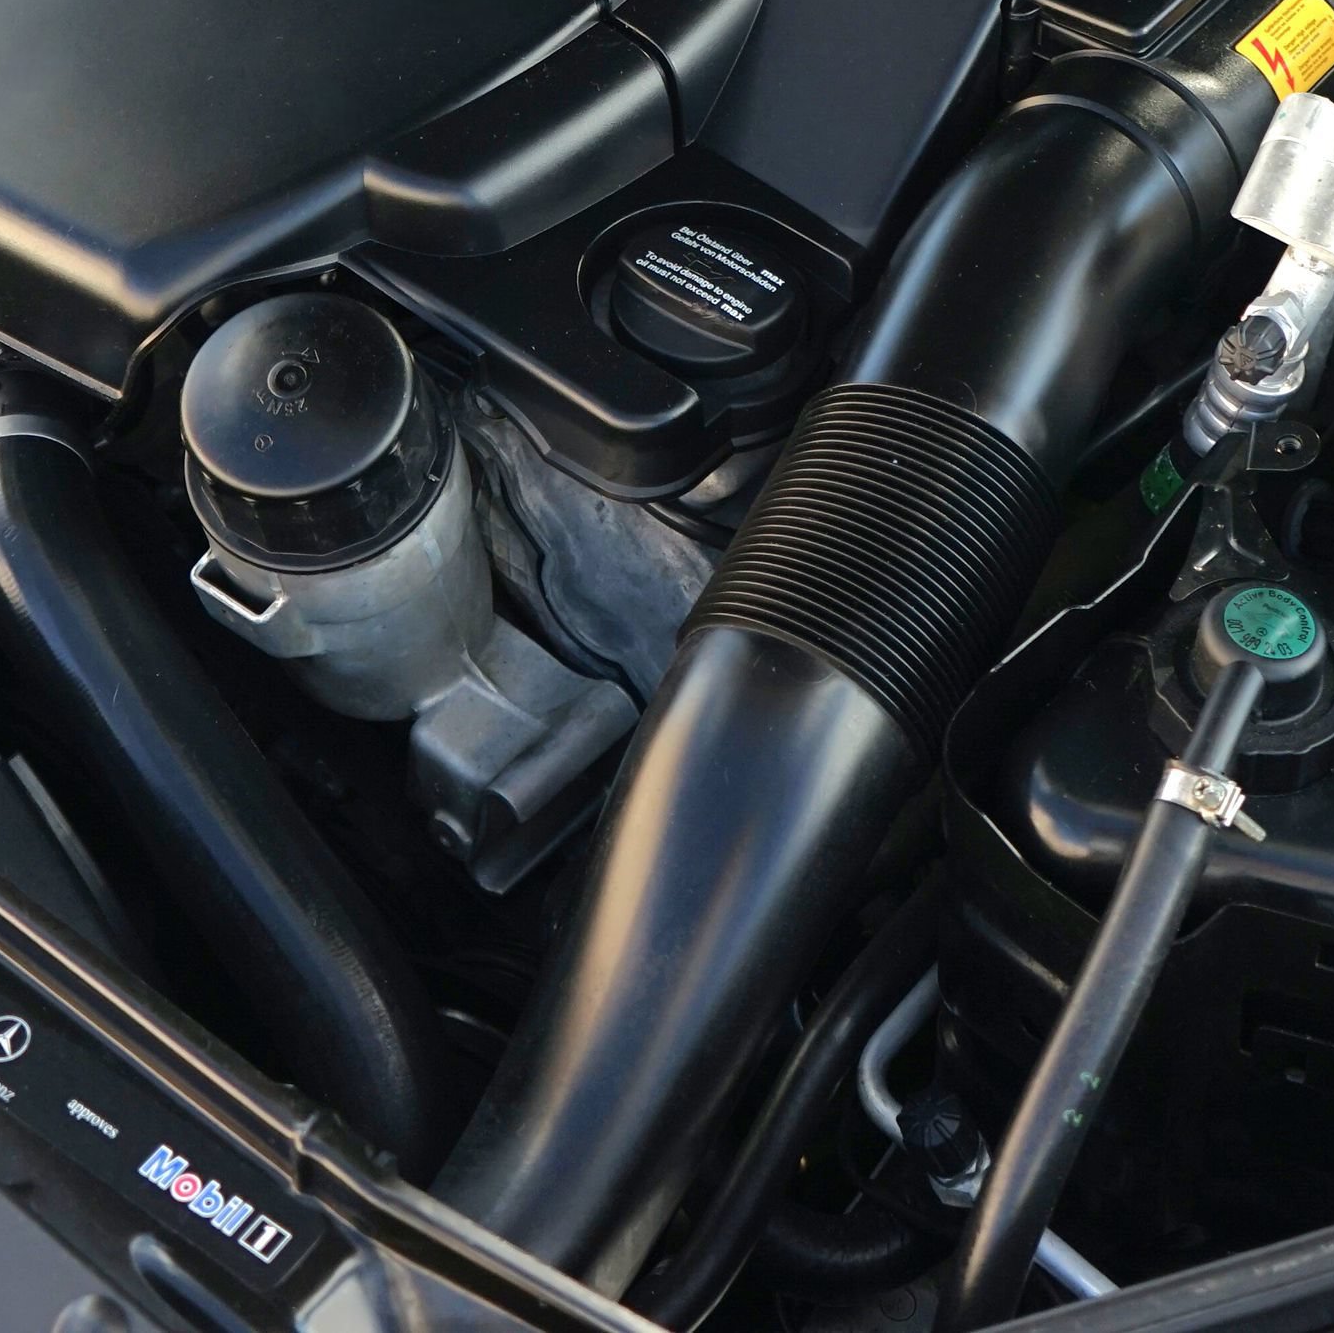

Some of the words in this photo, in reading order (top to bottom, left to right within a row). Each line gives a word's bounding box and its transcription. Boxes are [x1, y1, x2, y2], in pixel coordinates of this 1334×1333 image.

[645, 251, 658, 260] To
[655, 257, 682, 272] avoid
[680, 266, 715, 290] damage
[712, 286, 724, 296] to
[722, 291, 753, 315] engine
[670, 232, 701, 249] Gefahr
[699, 245, 716, 257] von
[715, 253, 777, 293] Motorschäden
[679, 226, 697, 236] Bei
[696, 233, 733, 255] Ölstand
[731, 249, 754, 267] über
[760, 269, 785, 287] max
[635, 258, 649, 268] oil
[646, 263, 672, 278] must
[669, 274, 687, 286] not
[684, 282, 721, 305] exceed
[720, 302, 746, 322] max
[1233, 590, 1264, 610] Active
[1268, 589, 1296, 606] Body
[1294, 607, 1311, 643] Control
[1239, 632, 1261, 650] 989
[1277, 642, 1293, 655] 03
[66, 1097, 119, 1140] approves
[138, 1144, 254, 1237] Mobil
